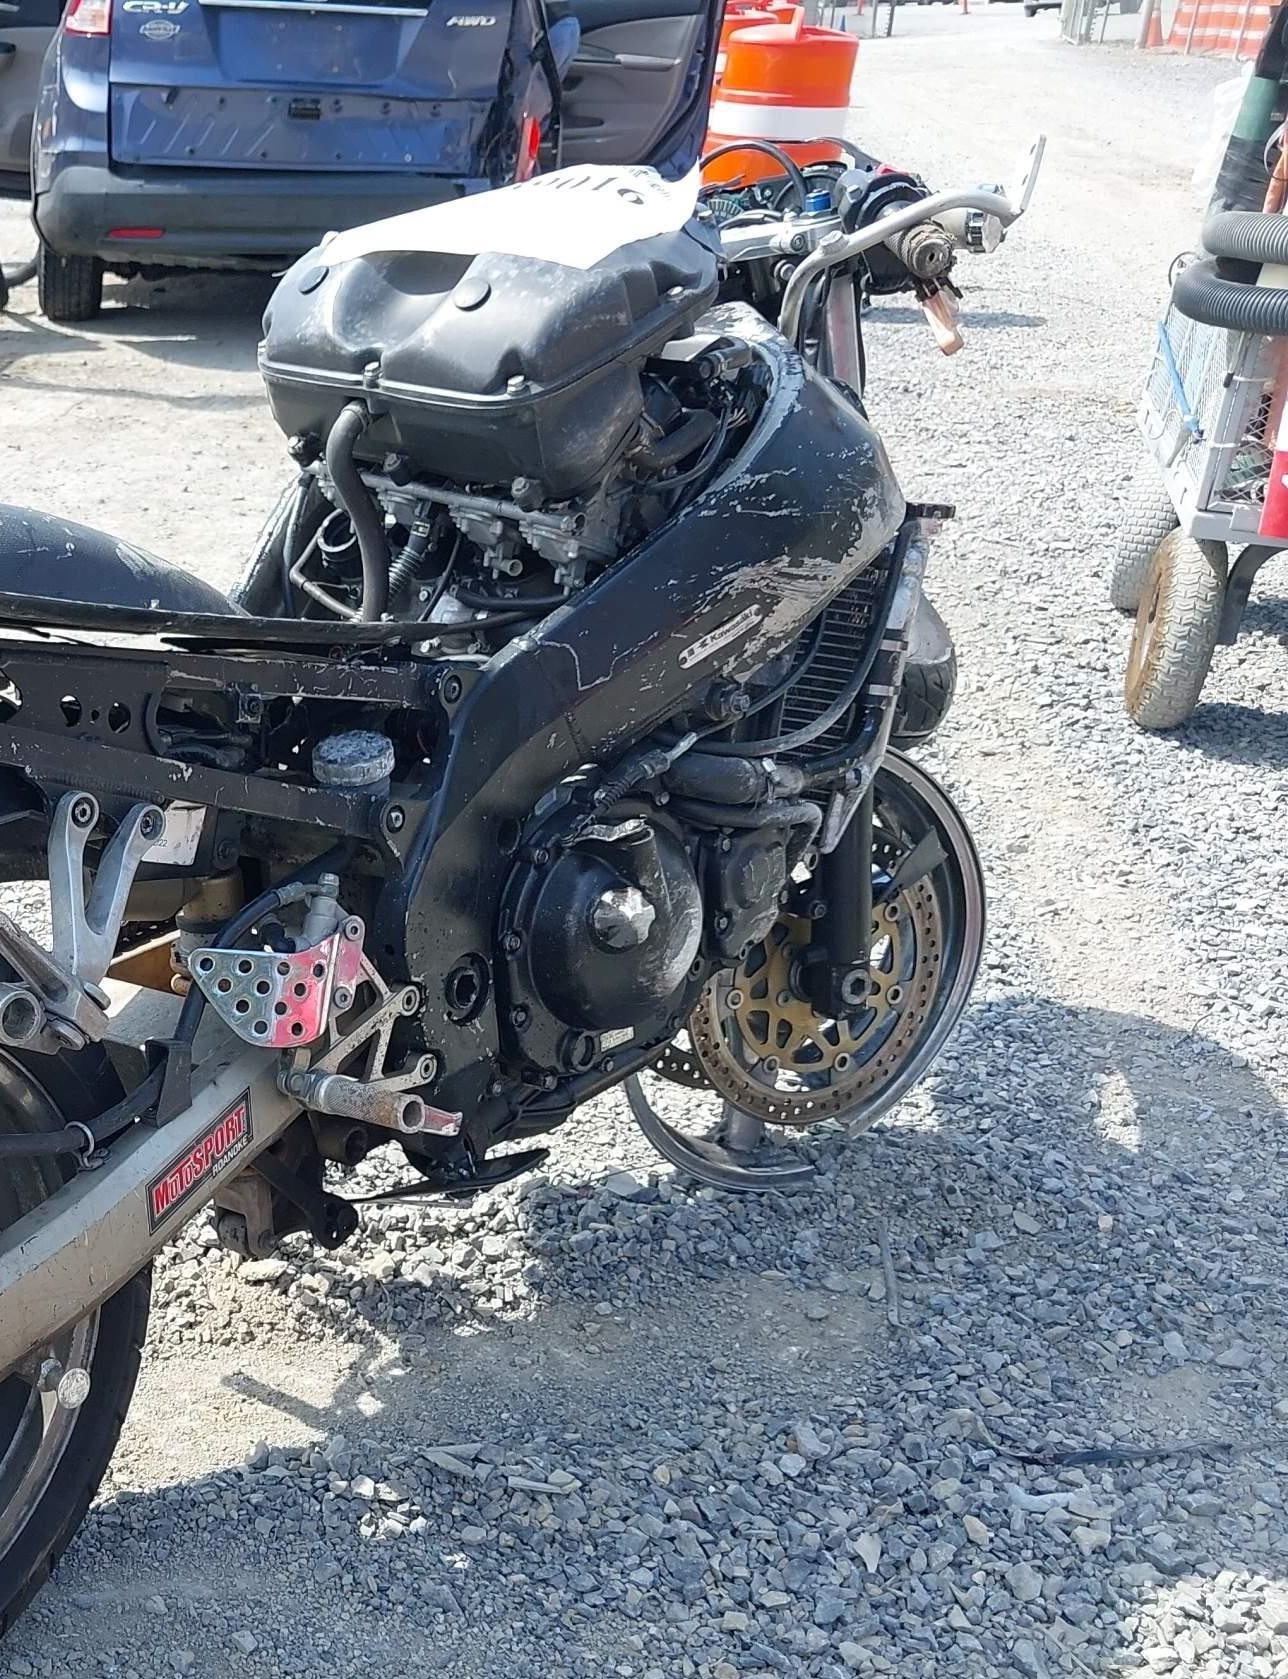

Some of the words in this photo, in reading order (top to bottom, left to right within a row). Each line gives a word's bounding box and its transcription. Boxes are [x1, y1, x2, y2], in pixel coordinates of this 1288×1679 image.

[123, 1, 189, 14] CR-V
[446, 15, 496, 26] AWD
[212, 1134, 249, 1177] ROANOKE
